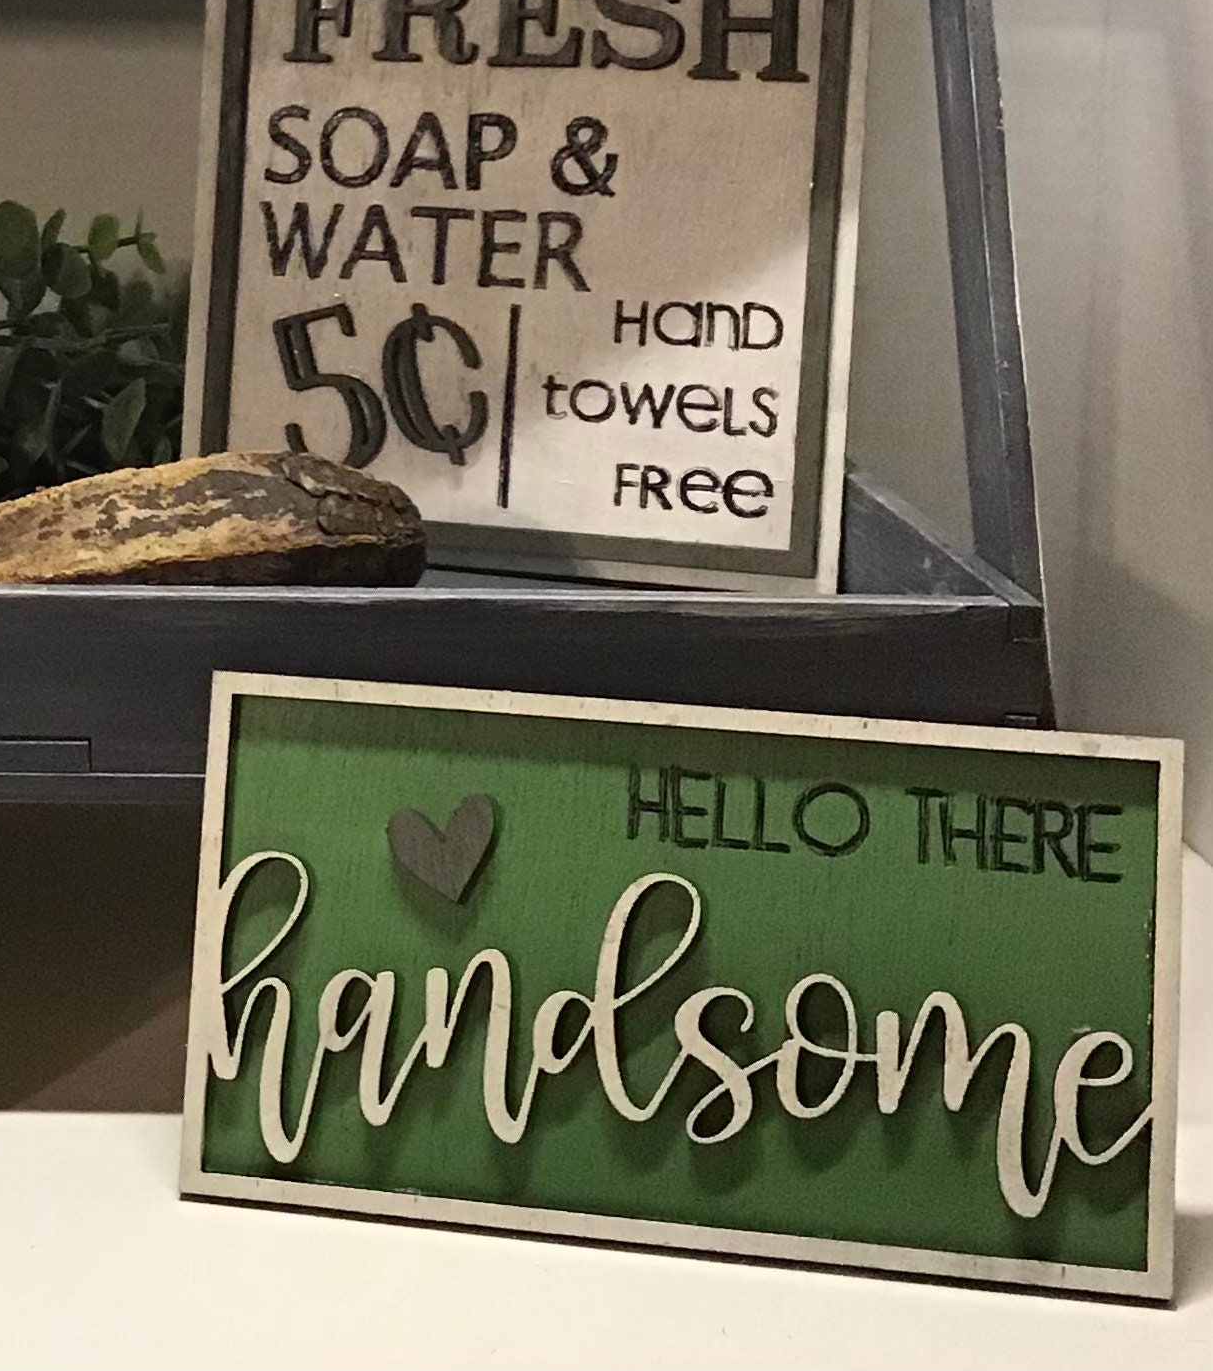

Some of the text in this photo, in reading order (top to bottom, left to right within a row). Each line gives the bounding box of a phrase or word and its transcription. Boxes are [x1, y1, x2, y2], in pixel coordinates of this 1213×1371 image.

[263, 104, 620, 198] SOAP &
[259, 200, 592, 293] WATER
[625, 763, 1124, 884] HELLO THERE
[205, 849, 1154, 1220] handsome
